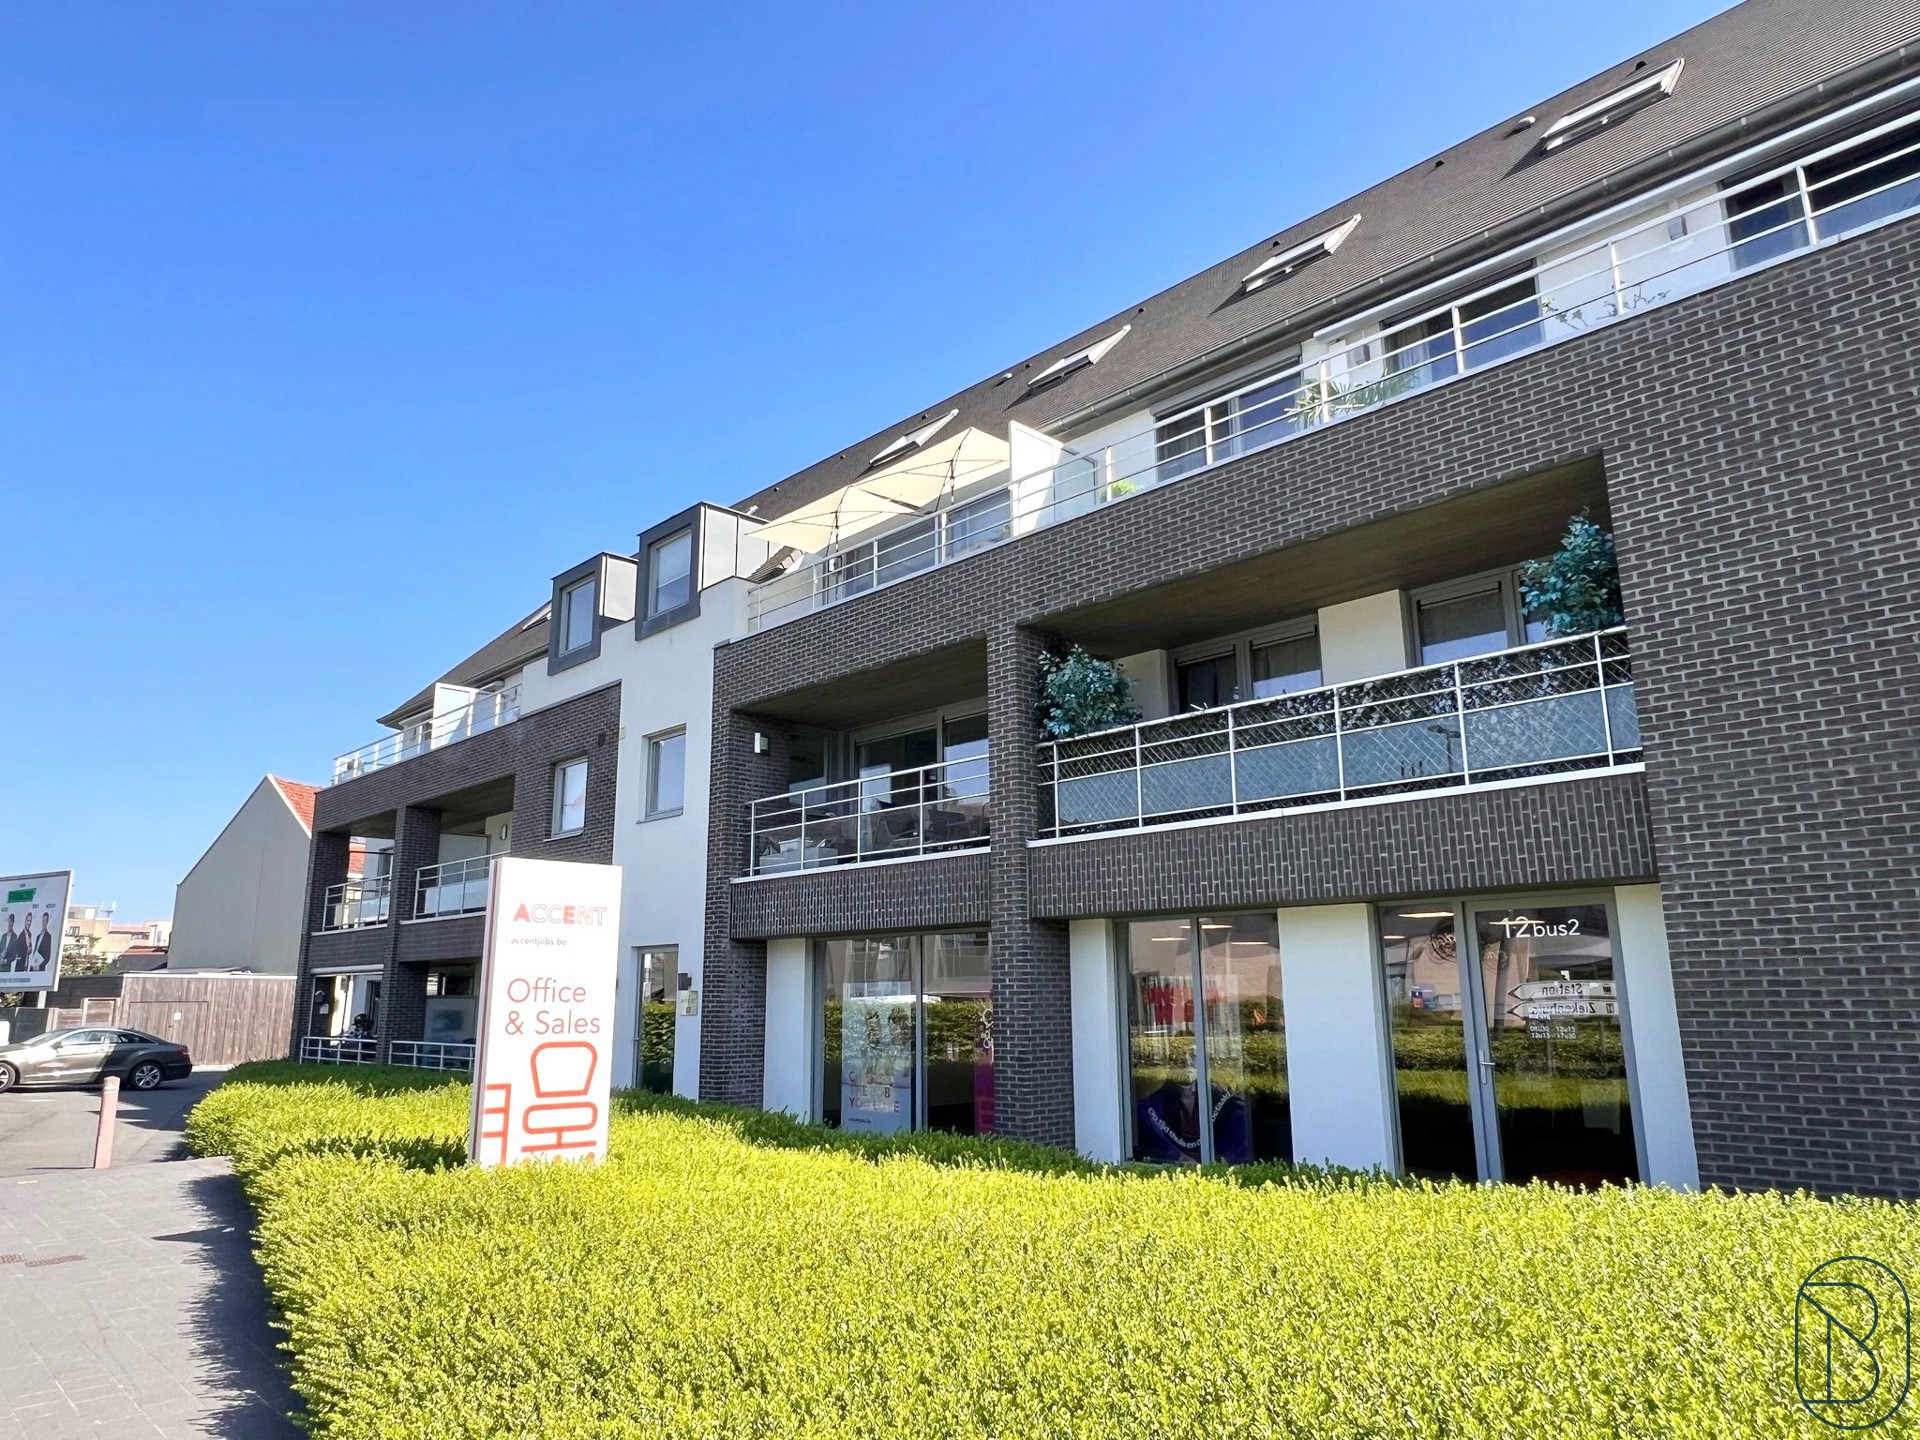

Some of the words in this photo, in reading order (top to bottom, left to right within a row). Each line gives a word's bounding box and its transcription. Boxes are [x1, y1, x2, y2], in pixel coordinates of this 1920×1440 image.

[512, 903, 608, 926] ACCENT
[510, 937, 568, 947] accentjobs.be
[507, 977, 586, 1003] Office
[505, 1010, 524, 1036] &
[535, 1009, 601, 1036] Sales
